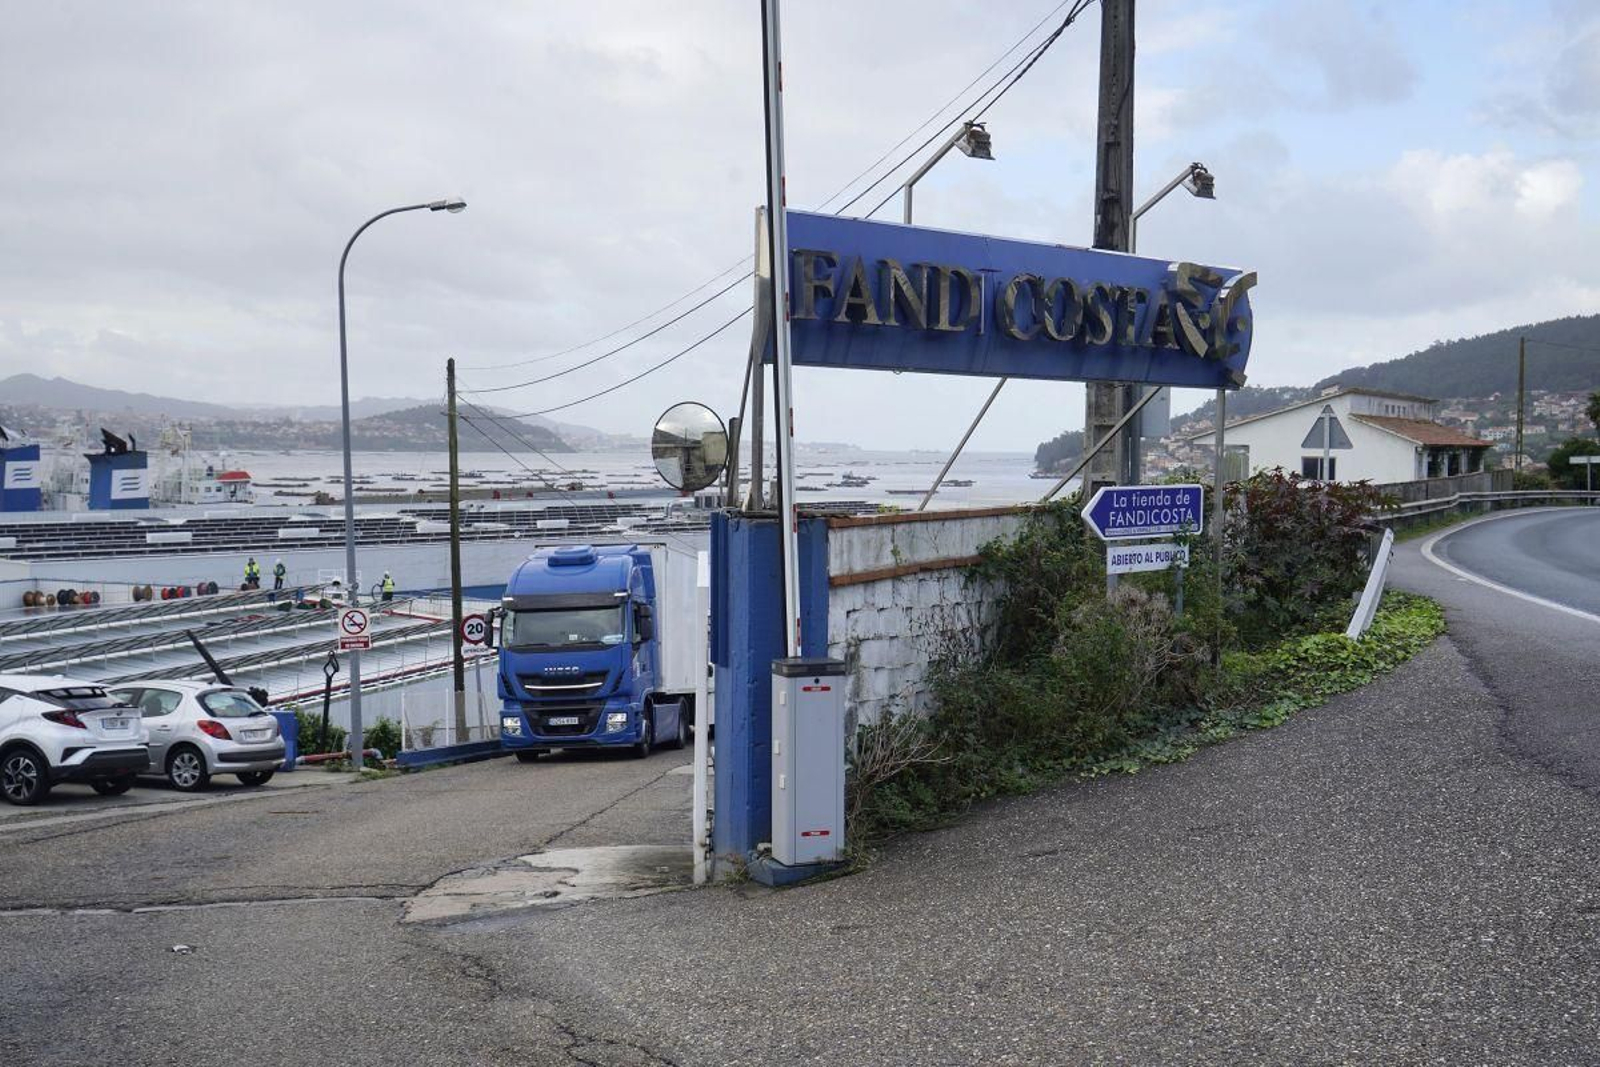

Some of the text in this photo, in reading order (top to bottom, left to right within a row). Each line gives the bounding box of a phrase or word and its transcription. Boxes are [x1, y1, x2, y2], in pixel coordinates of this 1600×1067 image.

[1113, 489, 1190, 508] La tienda de
[1109, 508, 1193, 527] FANDICOSTA
[1111, 552, 1142, 566] ABIERTO
[1144, 552, 1154, 564] AL
[467, 622, 483, 635] 20
